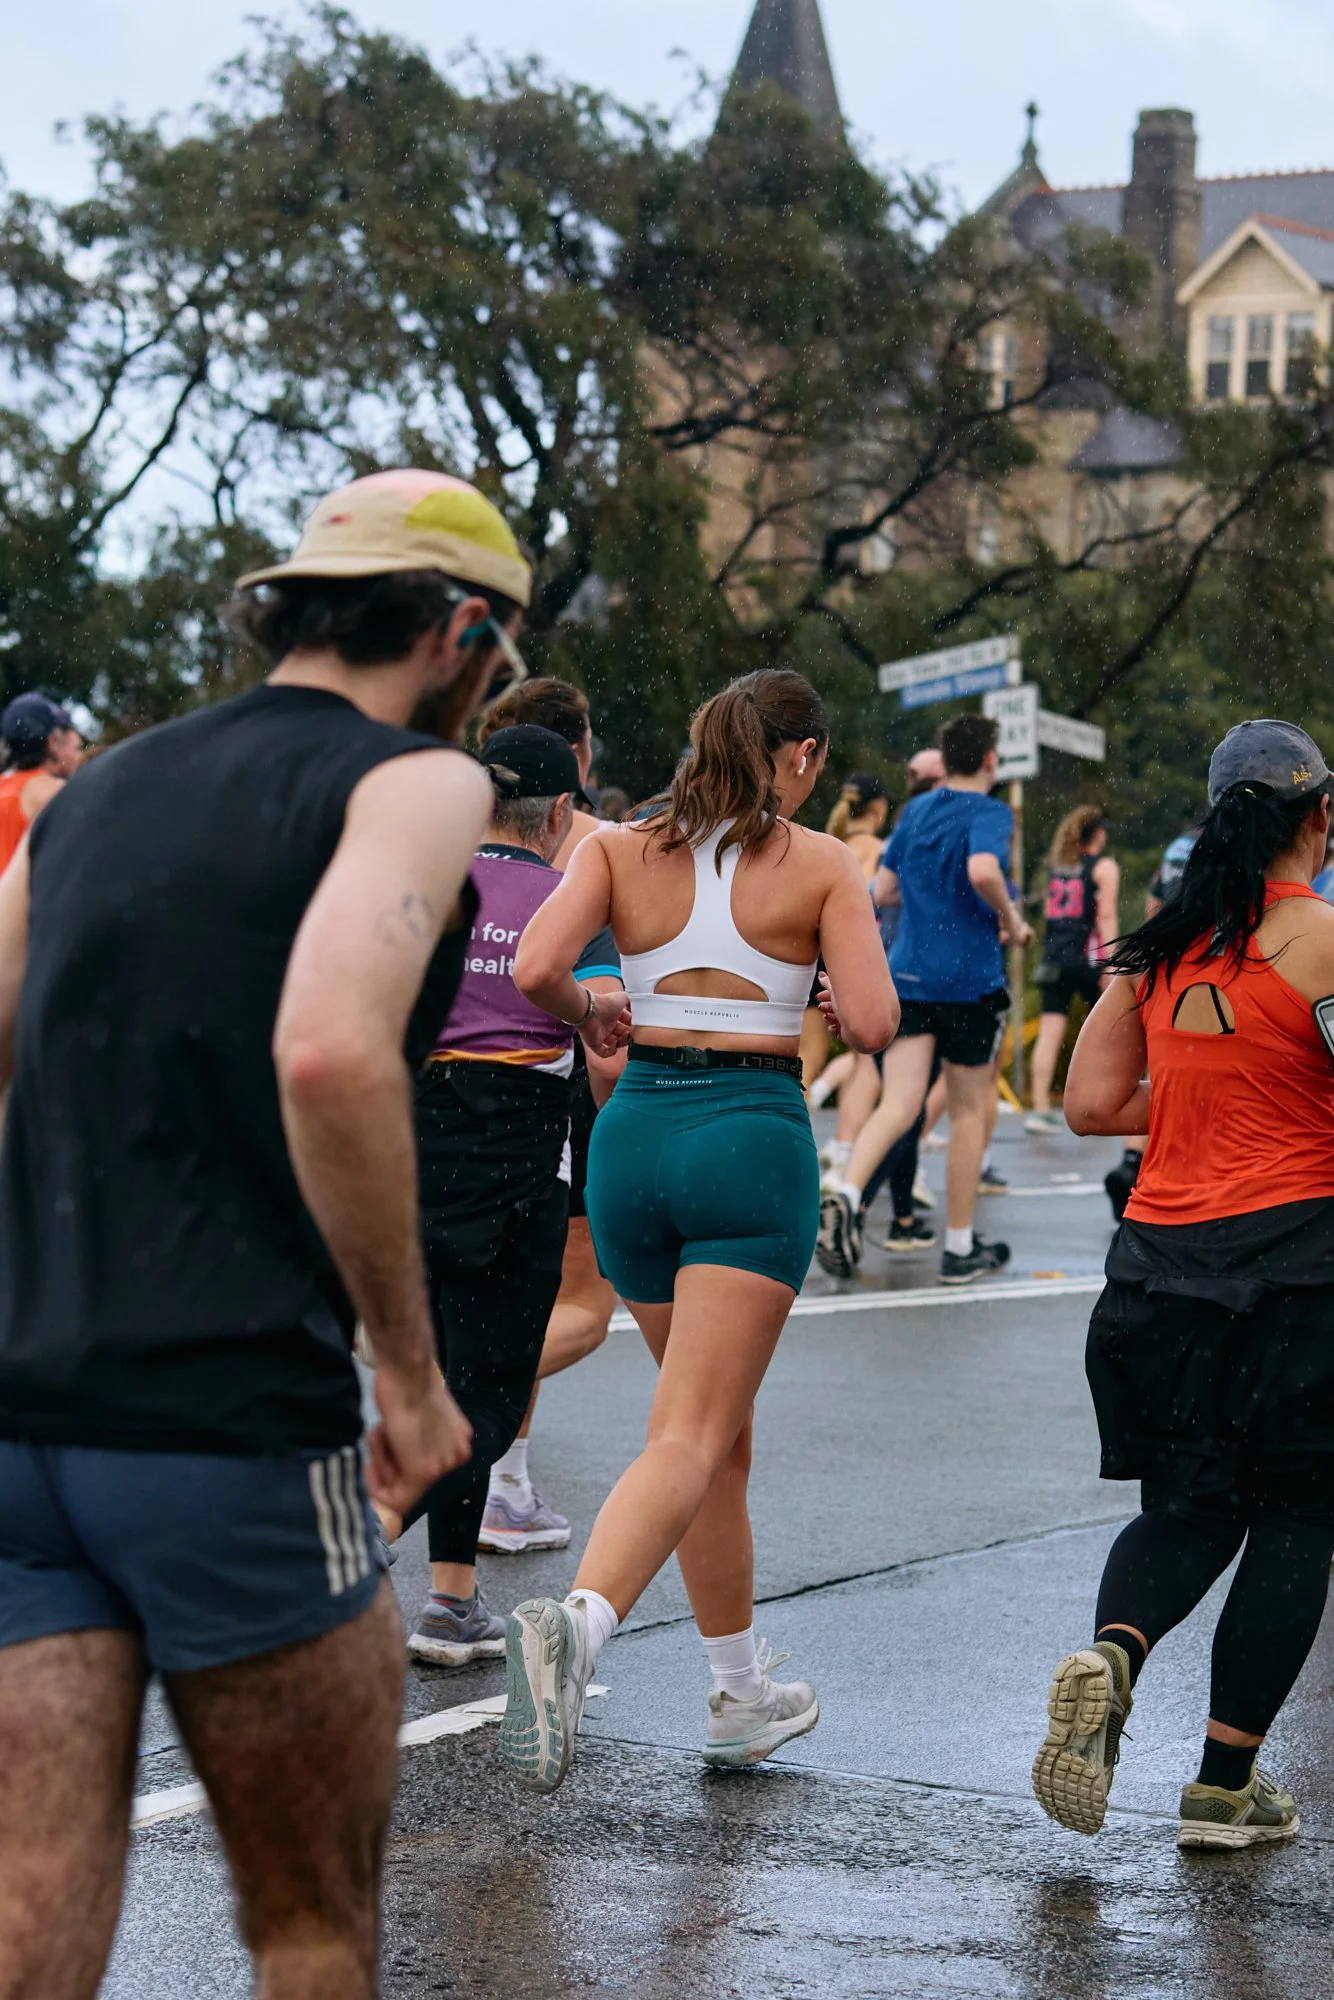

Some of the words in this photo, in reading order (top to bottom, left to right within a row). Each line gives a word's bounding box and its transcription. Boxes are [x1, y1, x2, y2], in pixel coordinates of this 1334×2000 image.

[1045, 877, 1085, 919] 23
[482, 922, 519, 944] for
[738, 1056, 801, 1075] PIBELT
